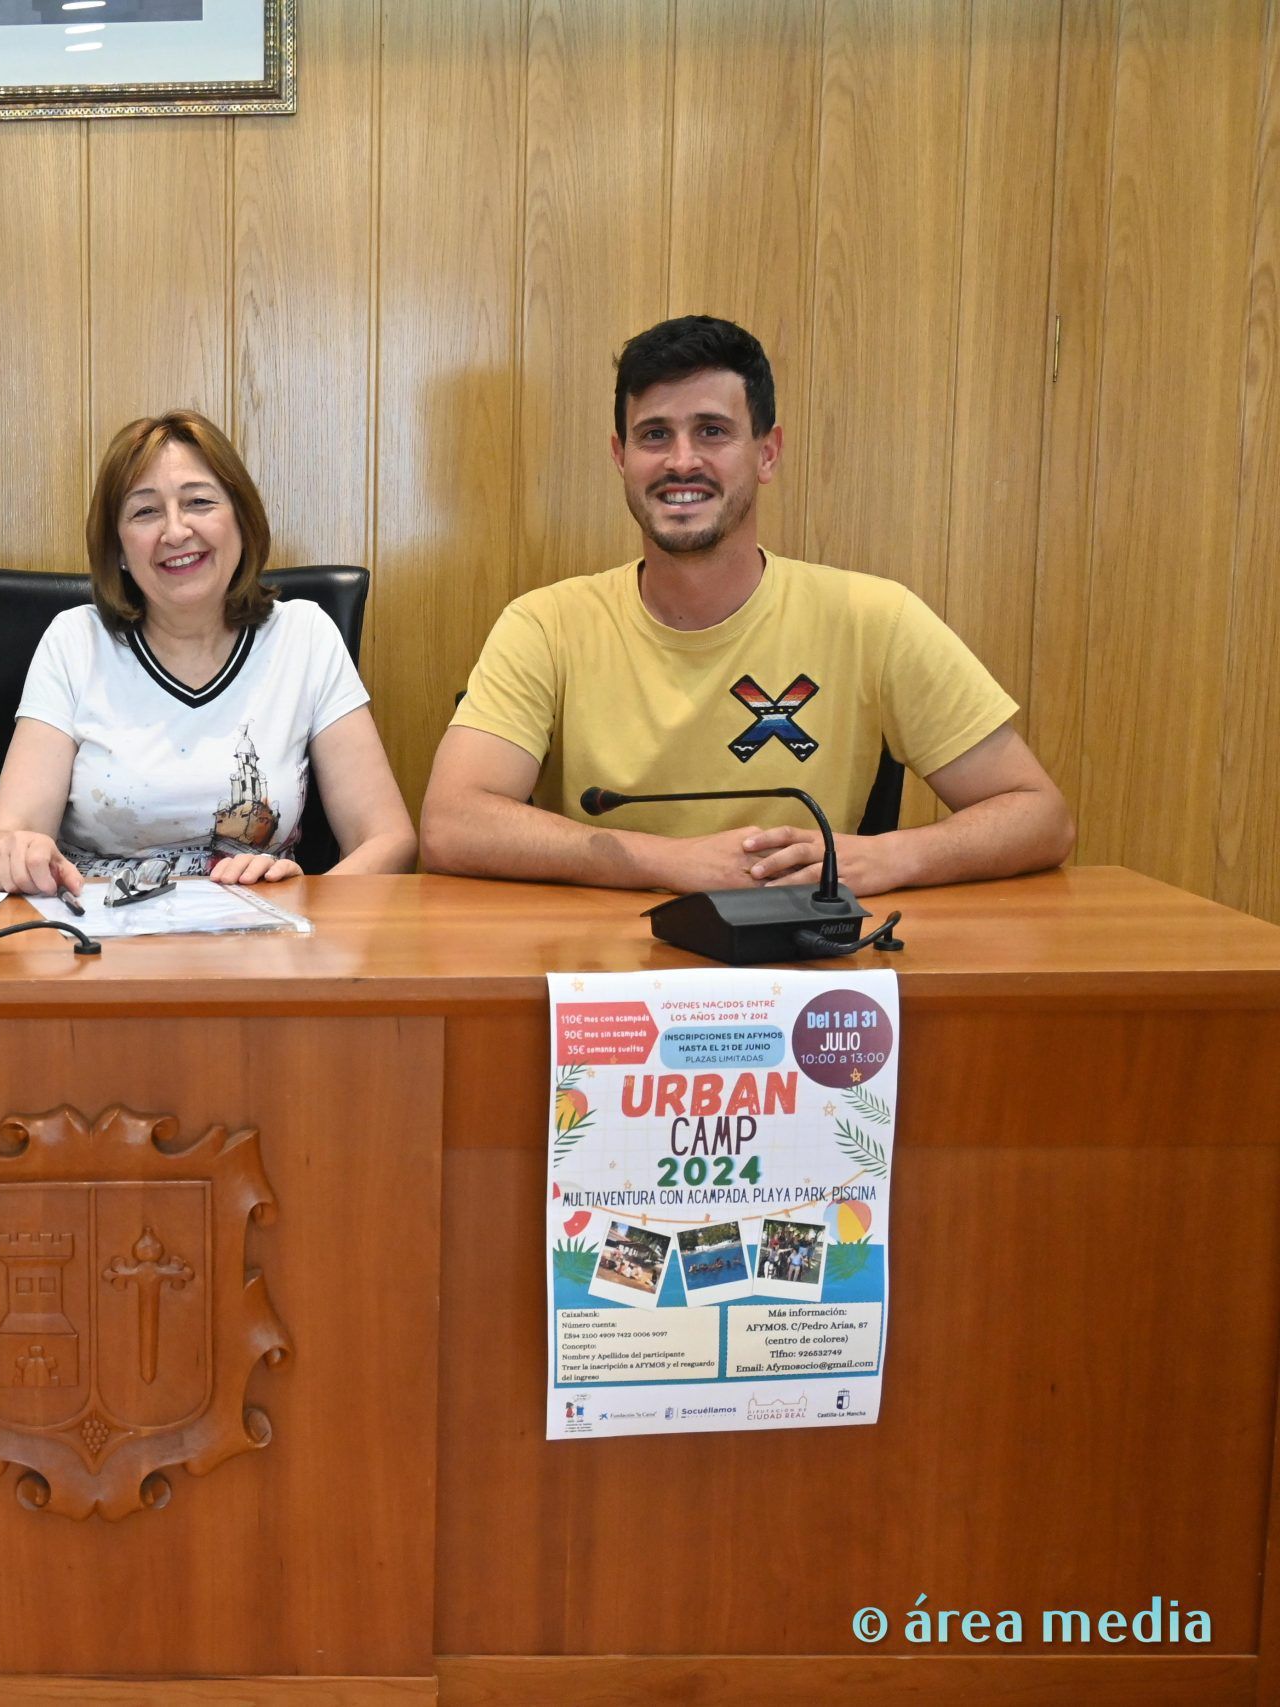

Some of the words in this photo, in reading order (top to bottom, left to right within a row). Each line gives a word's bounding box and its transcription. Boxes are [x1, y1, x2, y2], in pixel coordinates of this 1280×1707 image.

[661, 1000, 700, 1010] JÓVENES
[703, 1001, 744, 1009] NACIDOS
[747, 1000, 775, 1008] ENTRE
[561, 1015, 583, 1024] 110€
[615, 1014, 649, 1024] acampada
[671, 1013, 686, 1021] LOS
[689, 1011, 715, 1021] AÑOS
[807, 1011, 829, 1029] Del
[833, 1012, 840, 1028] 1
[845, 1011, 858, 1028] al
[861, 1011, 877, 1027] 31
[564, 1030, 583, 1039] 90€
[600, 1030, 611, 1038] sin
[613, 1029, 647, 1039] acampada
[665, 1033, 731, 1041] INSCRIPCIONES
[733, 1032, 745, 1040] EN
[747, 1031, 783, 1040] AFYMOS
[820, 1032, 860, 1052] JULIO
[568, 1045, 585, 1054] 35€
[618, 1045, 644, 1053] sueltas
[679, 1044, 706, 1052] HASTA
[709, 1044, 719, 1052] EL
[745, 1043, 770, 1051] JUNIO
[685, 1055, 716, 1063] PLAZAS
[801, 1053, 836, 1065] 10:00
[839, 1056, 846, 1064] a
[850, 1052, 885, 1064] 13:00
[621, 1072, 798, 1117] URBAN
[672, 1116, 757, 1156] CAMP
[657, 1156, 762, 1187] 2024
[563, 1191, 656, 1207] MULTIAVENTURA
[660, 1190, 683, 1204] CON
[753, 1188, 790, 1203] PLAYA
[832, 1186, 876, 1200] PISCINA
[768, 1310, 786, 1318] Más
[789, 1309, 847, 1317] información:
[746, 1324, 788, 1332] AFYMOS.
[791, 1322, 828, 1332] C/Pedro
[830, 1321, 856, 1330] Arias,
[765, 1337, 797, 1346] (centro
[813, 1335, 848, 1344] colores)
[798, 1349, 842, 1357] 926532749
[766, 1360, 873, 1372] Afymosocio@gmail.com
[681, 1407, 736, 1415] Socuéllamos
